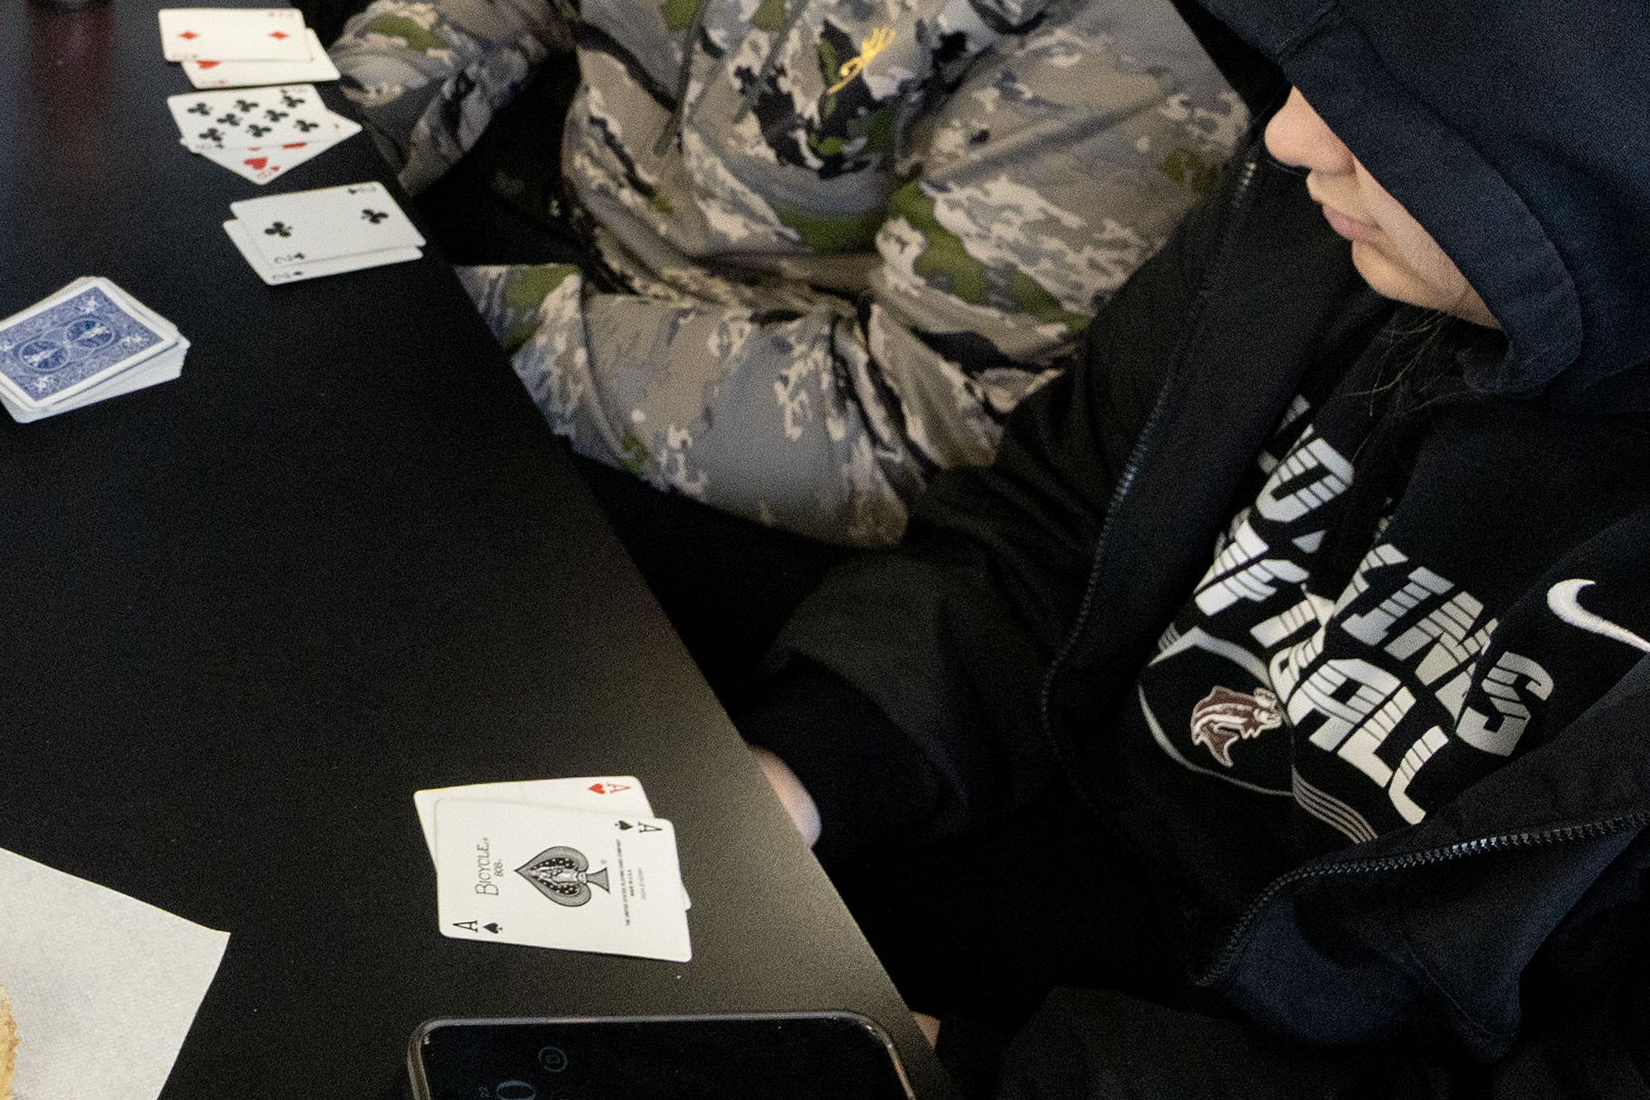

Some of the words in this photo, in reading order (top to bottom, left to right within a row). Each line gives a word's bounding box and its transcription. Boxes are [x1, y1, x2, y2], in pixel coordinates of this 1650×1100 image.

[607, 782, 631, 794] A
[638, 822, 663, 833] A
[453, 920, 478, 933] A
